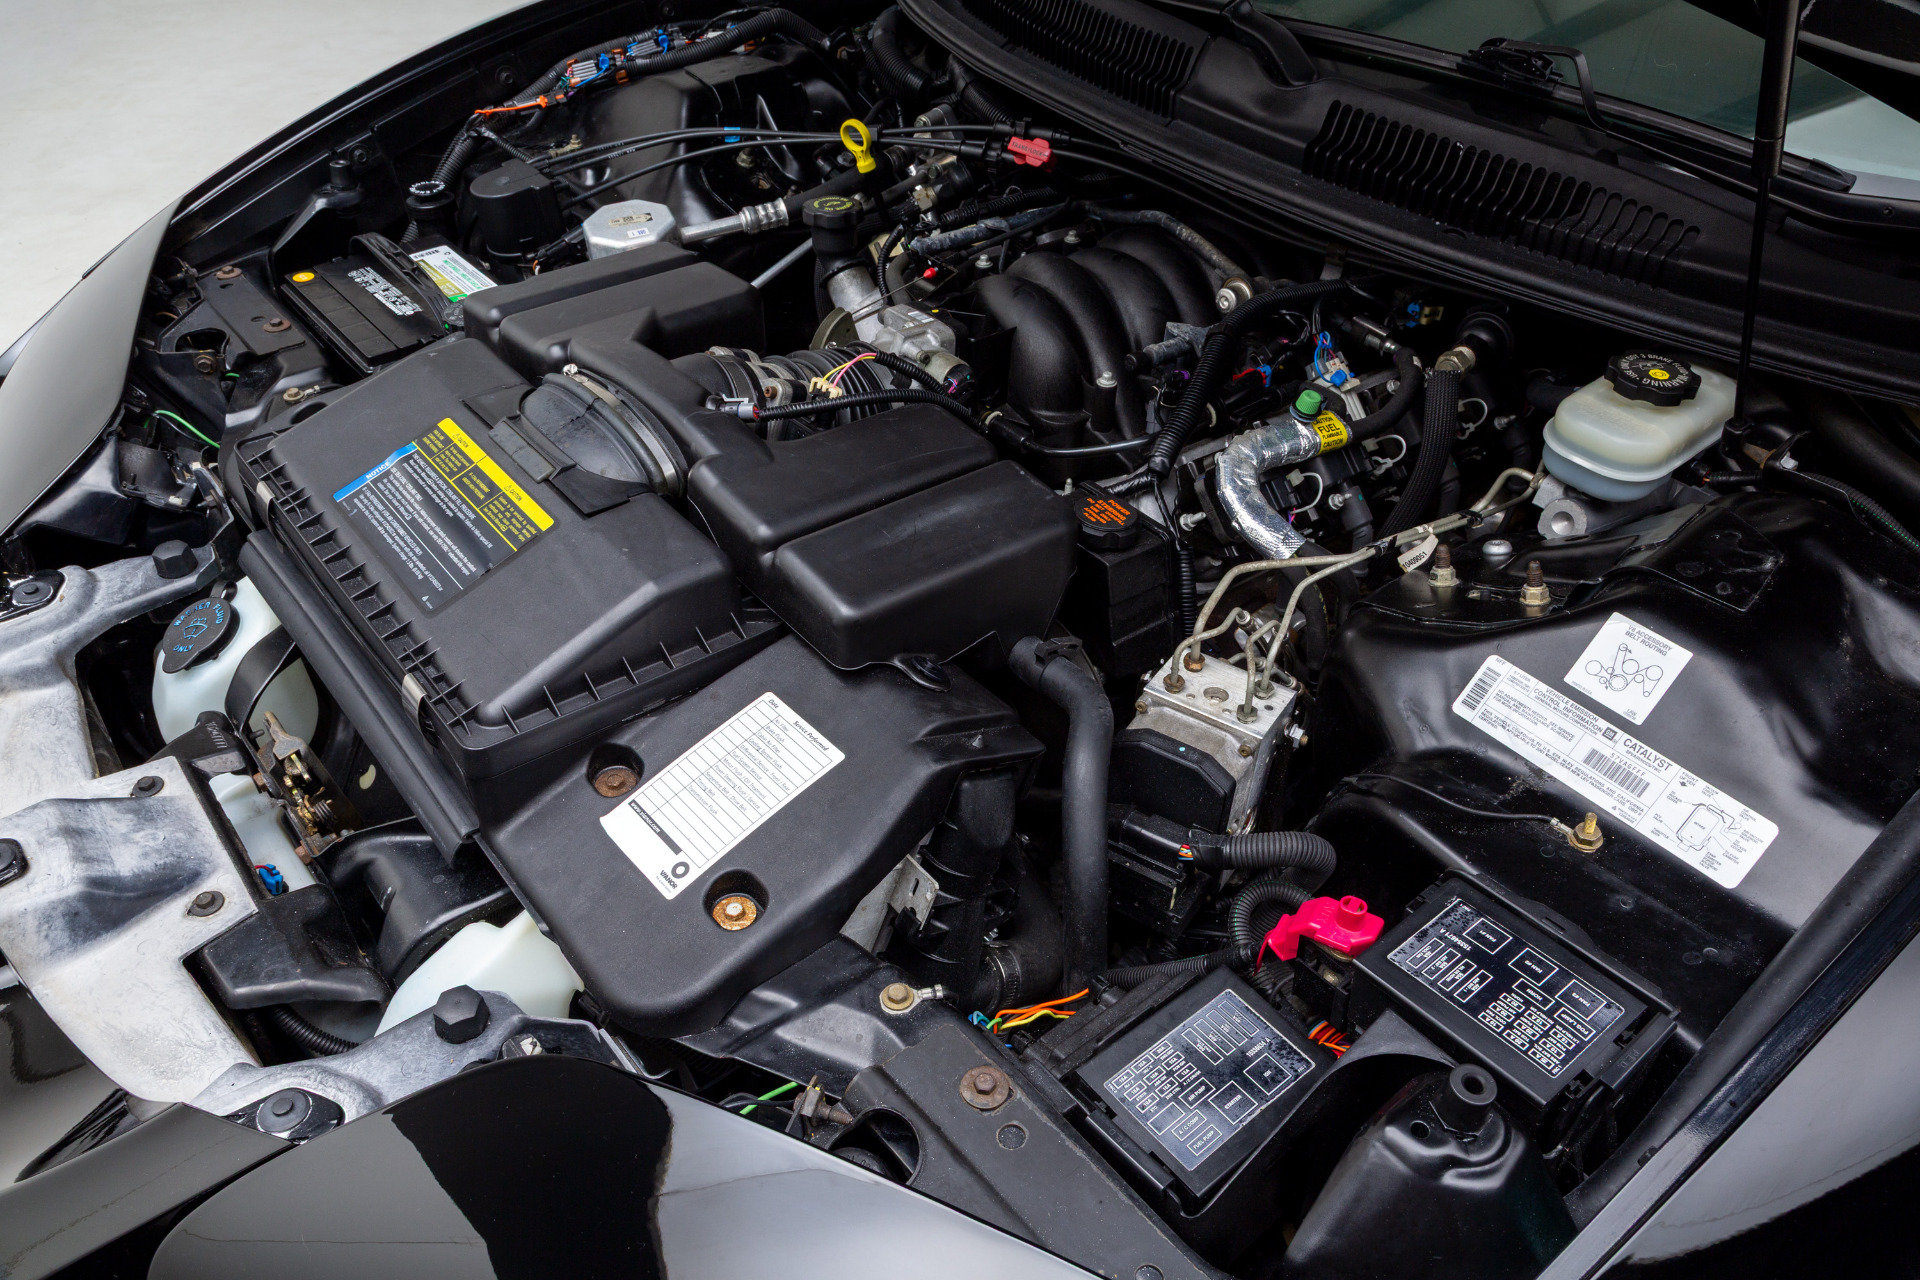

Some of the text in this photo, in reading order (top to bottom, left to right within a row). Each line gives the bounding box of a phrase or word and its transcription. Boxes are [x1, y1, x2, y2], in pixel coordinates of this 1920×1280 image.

[1317, 423, 1341, 434] FUEL
[1323, 438, 1344, 449] CAUTION
[1107, 499, 1131, 516] POWER
[173, 601, 224, 627] WASHER FLUID
[172, 643, 195, 653] ONLY
[1624, 630, 1668, 656] BELT ROUTING
[1635, 629, 1672, 652] ACCESSORY
[767, 698, 780, 709] Date
[1533, 687, 1561, 707] CONTROL
[1562, 705, 1603, 733] INFORMATION
[1544, 687, 1570, 705] VEHICLE
[1569, 702, 1599, 722] EMISSION
[1533, 694, 1598, 735] GENERAL MOTORS CORPORATION
[792, 720, 829, 752] Service Performed
[1622, 737, 1673, 772] CATALYST
[1616, 793, 1644, 812] CALIFORNIA
[1484, 933, 1497, 942] FAN
[1530, 964, 1543, 973] FAN
[1510, 992, 1524, 1002] HORN
[1525, 987, 1543, 1000] HORN
[1577, 996, 1591, 1007] FAN
[1495, 999, 1509, 1009] PUMP
[1484, 1008, 1506, 1025] COOL FAN
[1518, 1015, 1532, 1026] PUMP
[1559, 1012, 1589, 1034] FOG LAMP
[1262, 1069, 1271, 1077] IGN
[1187, 1085, 1206, 1101] AIR PUMP
[1224, 1094, 1242, 1109] STARTER
[1192, 1130, 1215, 1149] FUEL PUMP
